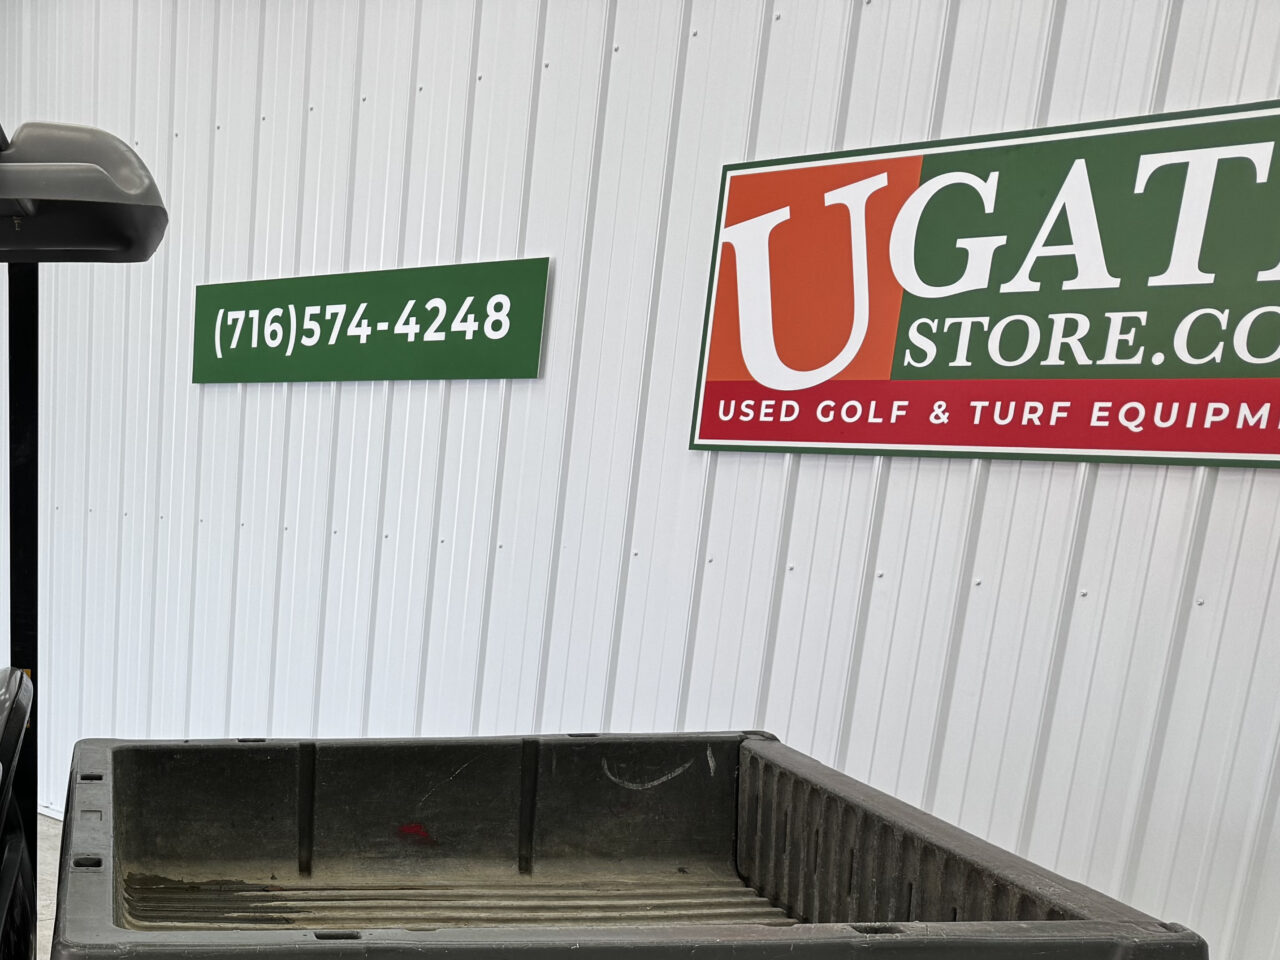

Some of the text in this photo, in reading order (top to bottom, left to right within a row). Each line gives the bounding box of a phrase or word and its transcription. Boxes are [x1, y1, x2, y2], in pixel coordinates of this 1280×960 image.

[722, 141, 1280, 391] UGAT
[214, 293, 511, 359] (716)574-4248
[717, 399, 1280, 433] USED GOLF & TURF EQUIPM
